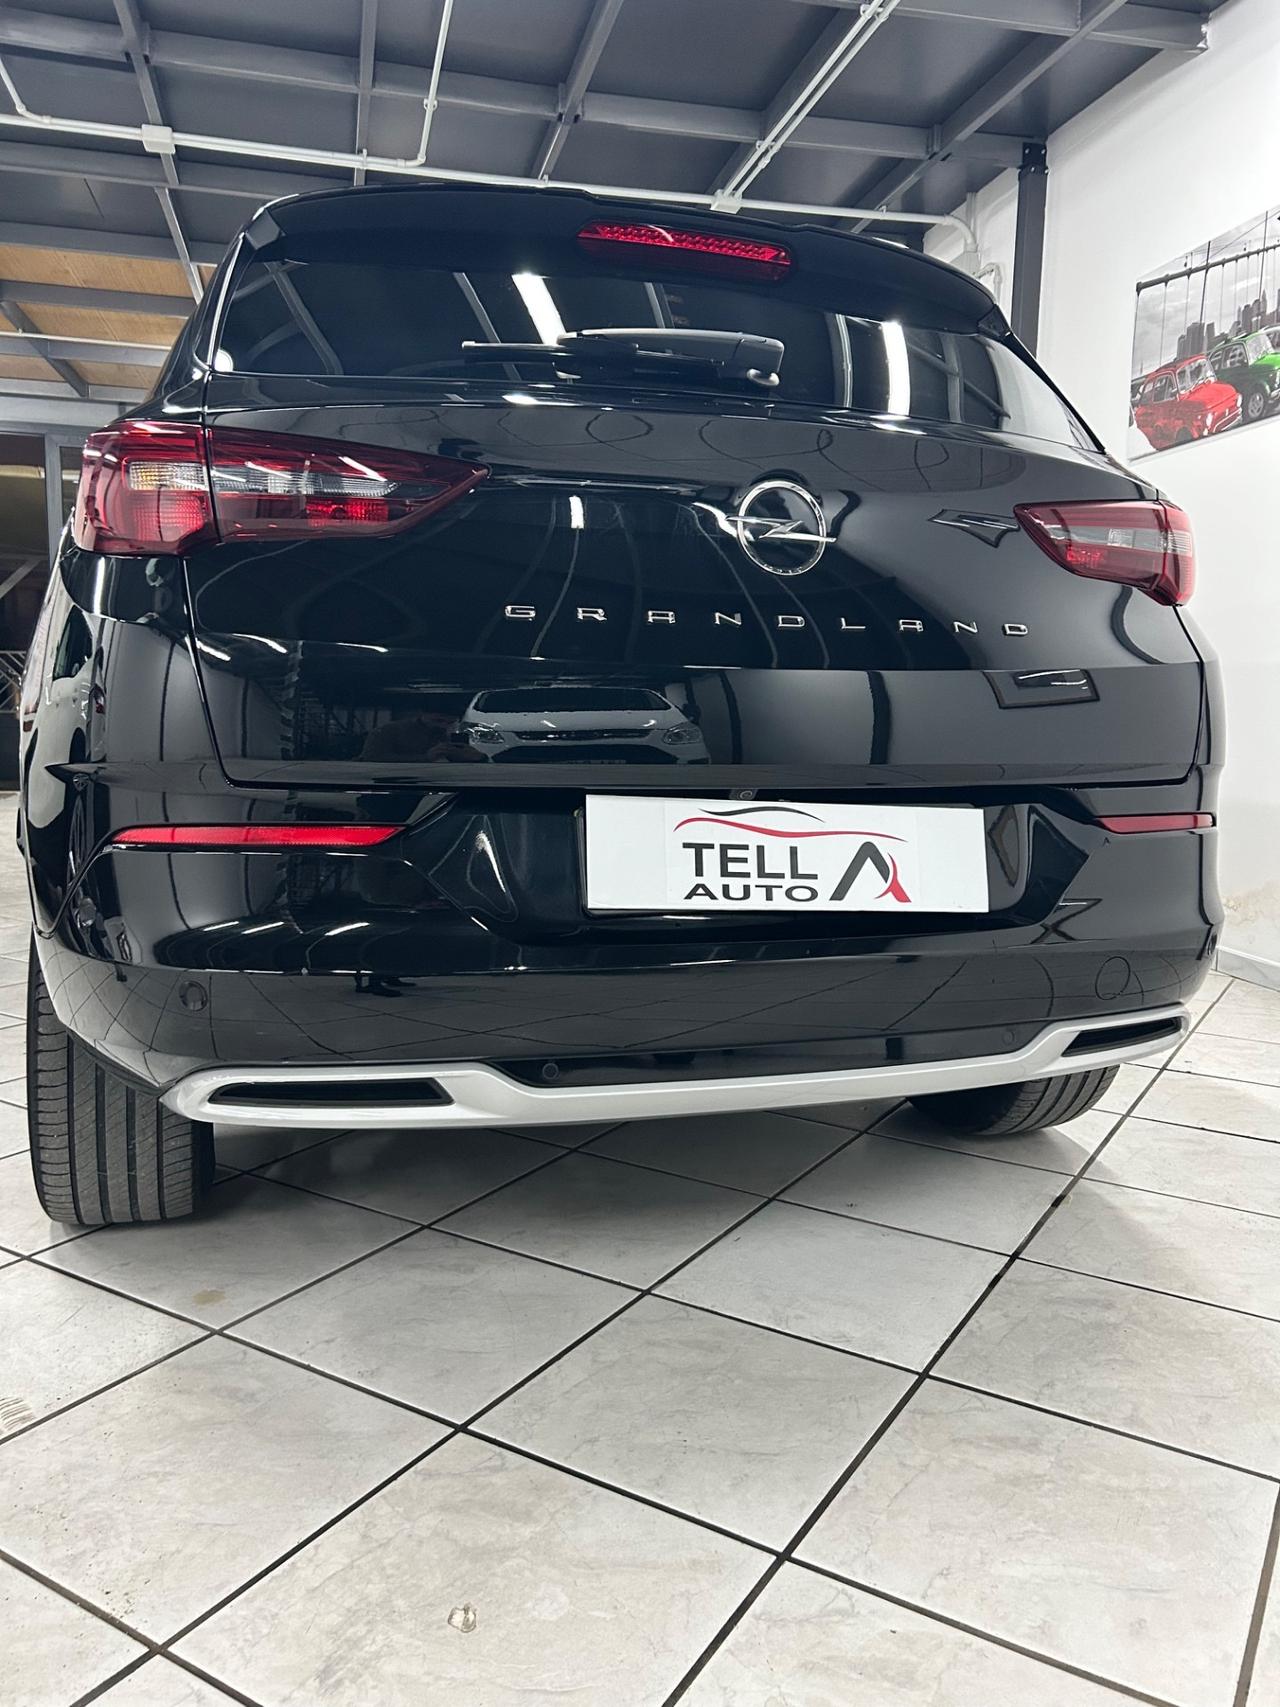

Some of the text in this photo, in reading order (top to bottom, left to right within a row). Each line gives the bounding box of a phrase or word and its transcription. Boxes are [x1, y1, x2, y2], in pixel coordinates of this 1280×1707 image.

[504, 604, 1029, 636] GRANDLAND
[682, 842, 818, 880] TELL
[683, 883, 819, 902] AUTO
